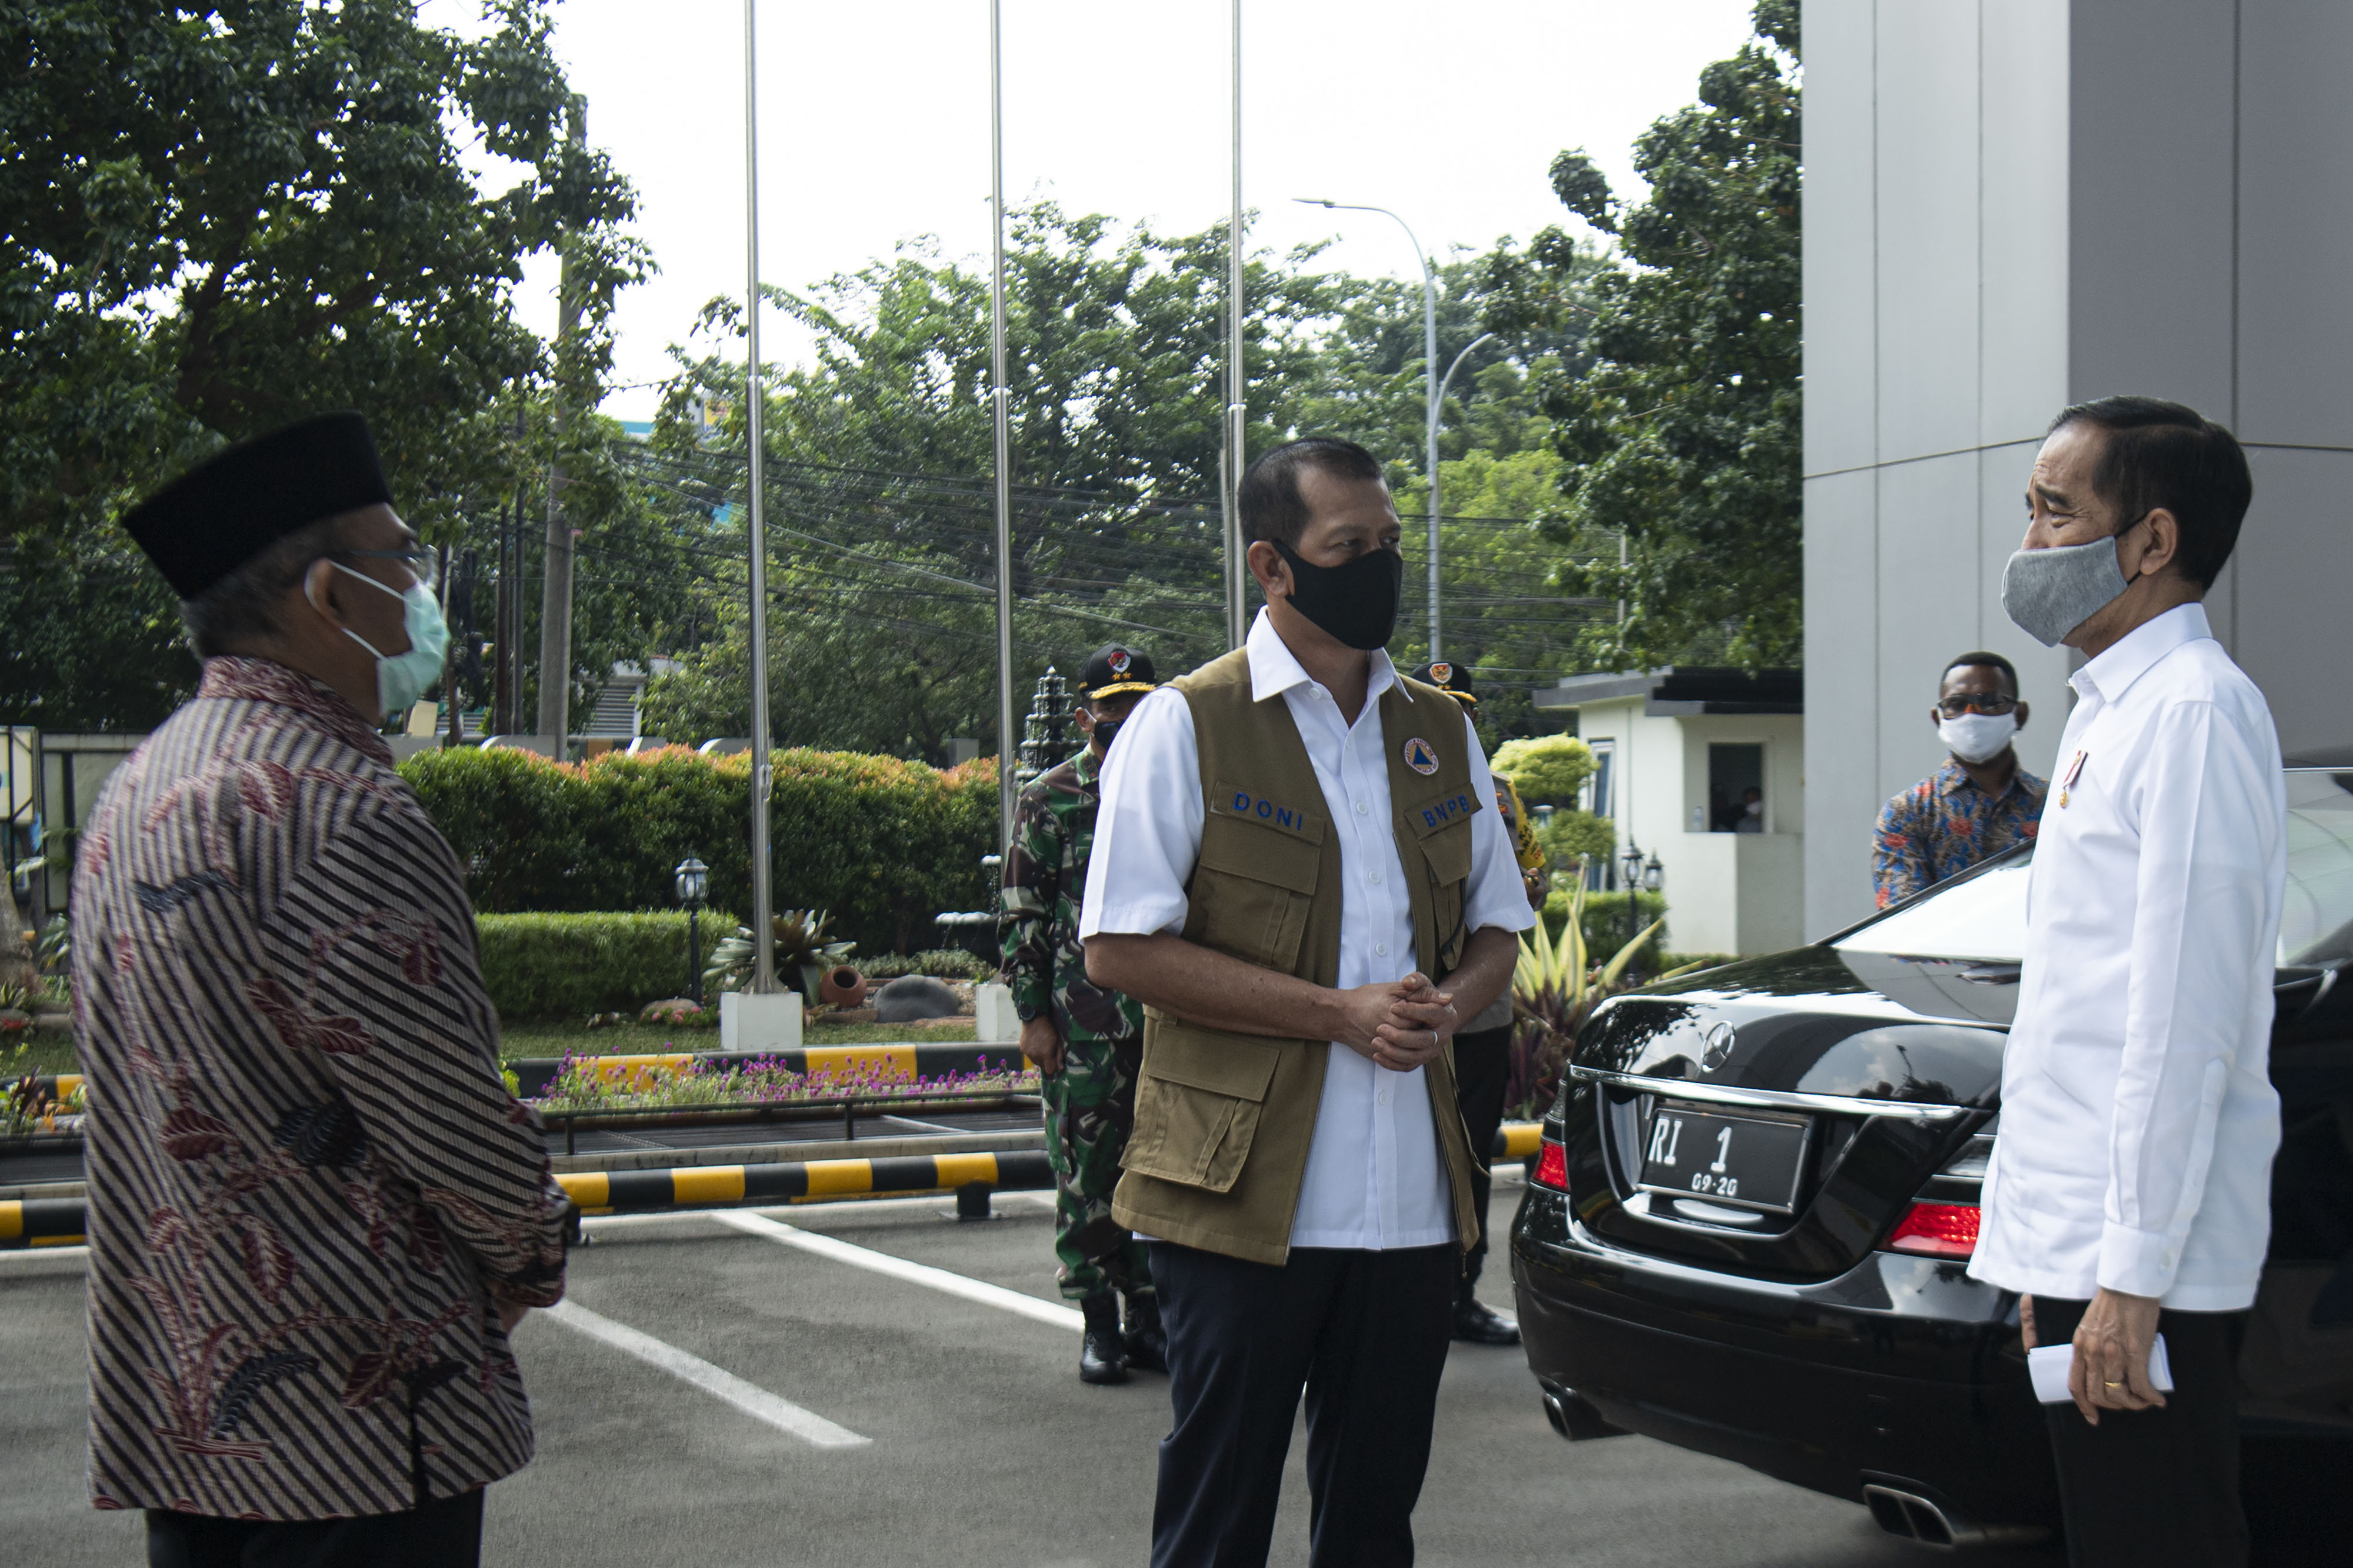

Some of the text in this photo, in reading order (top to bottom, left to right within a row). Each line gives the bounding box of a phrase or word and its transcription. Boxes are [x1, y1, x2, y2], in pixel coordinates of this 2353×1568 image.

[1232, 790, 1302, 831] DONI
[1422, 794, 1469, 828] BNPB
[1648, 1118, 1732, 1172] RI 1
